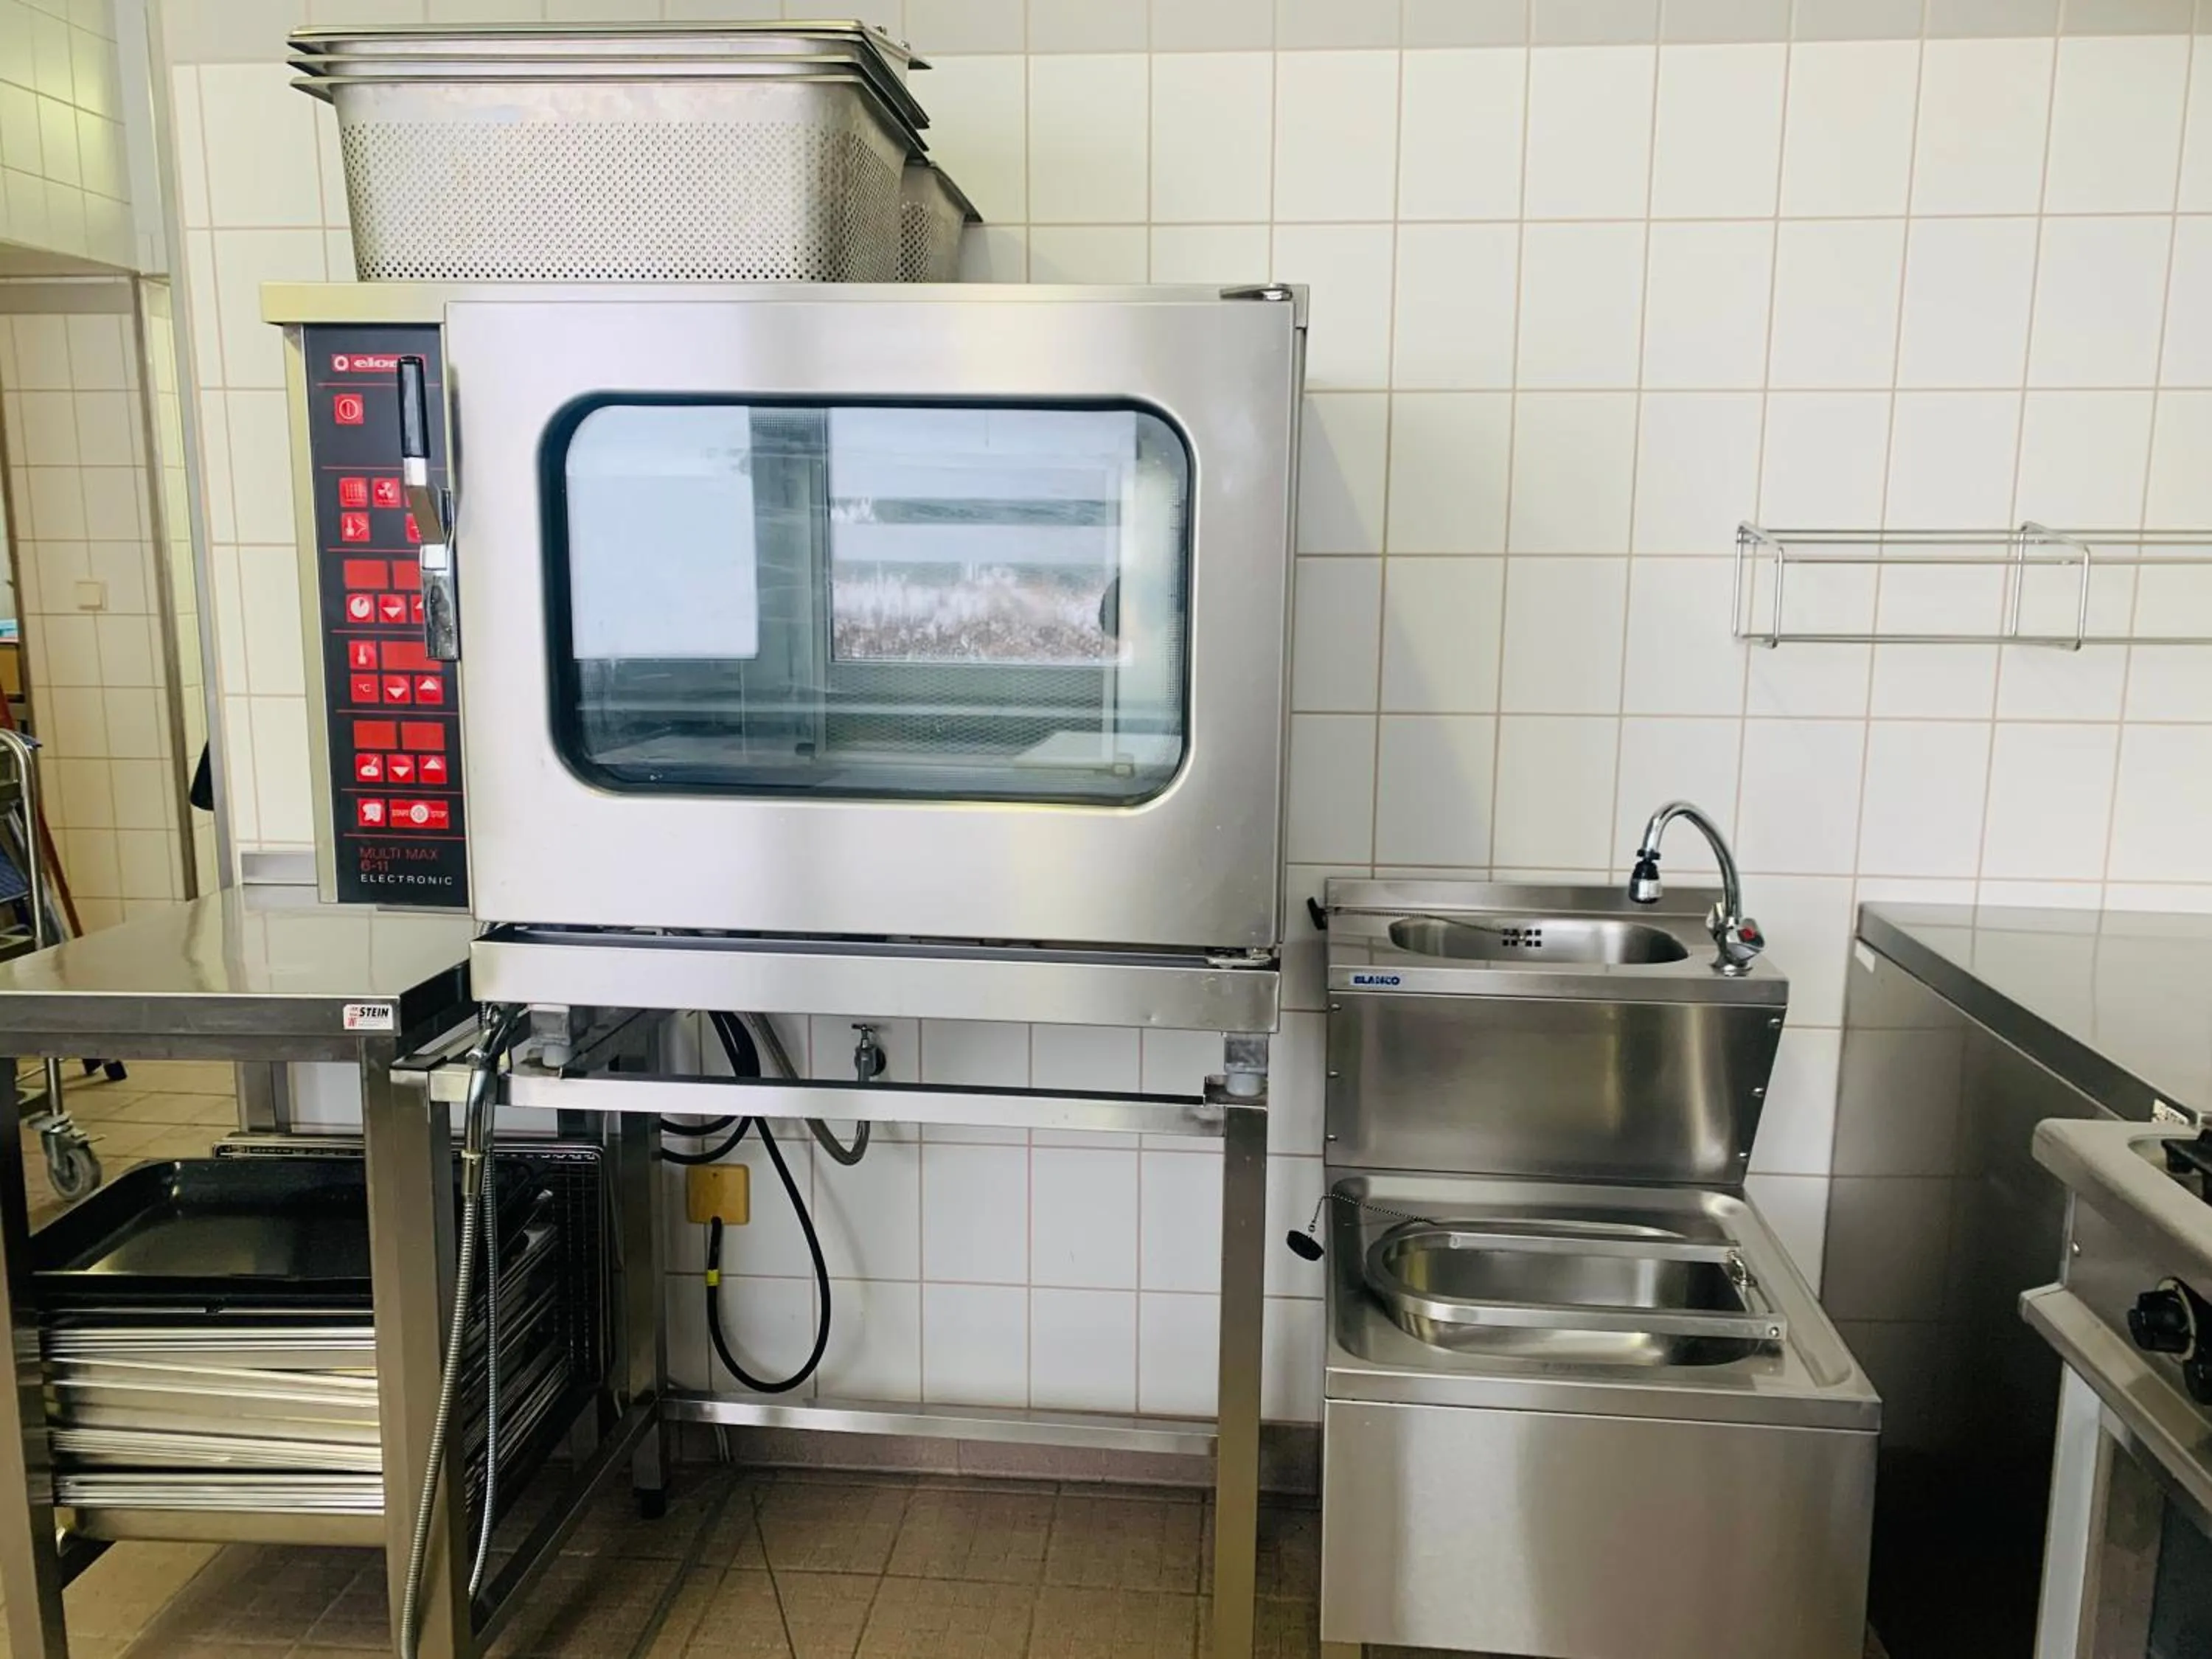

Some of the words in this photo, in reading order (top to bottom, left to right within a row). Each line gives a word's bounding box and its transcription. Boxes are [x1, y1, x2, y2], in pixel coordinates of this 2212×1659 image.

[360, 847, 400, 859] MULTI
[406, 849, 438, 860] MAX
[360, 874, 452, 885] ELECTRONIC
[1354, 975, 1400, 985] BLANCO
[359, 1006, 389, 1017] STEIN
